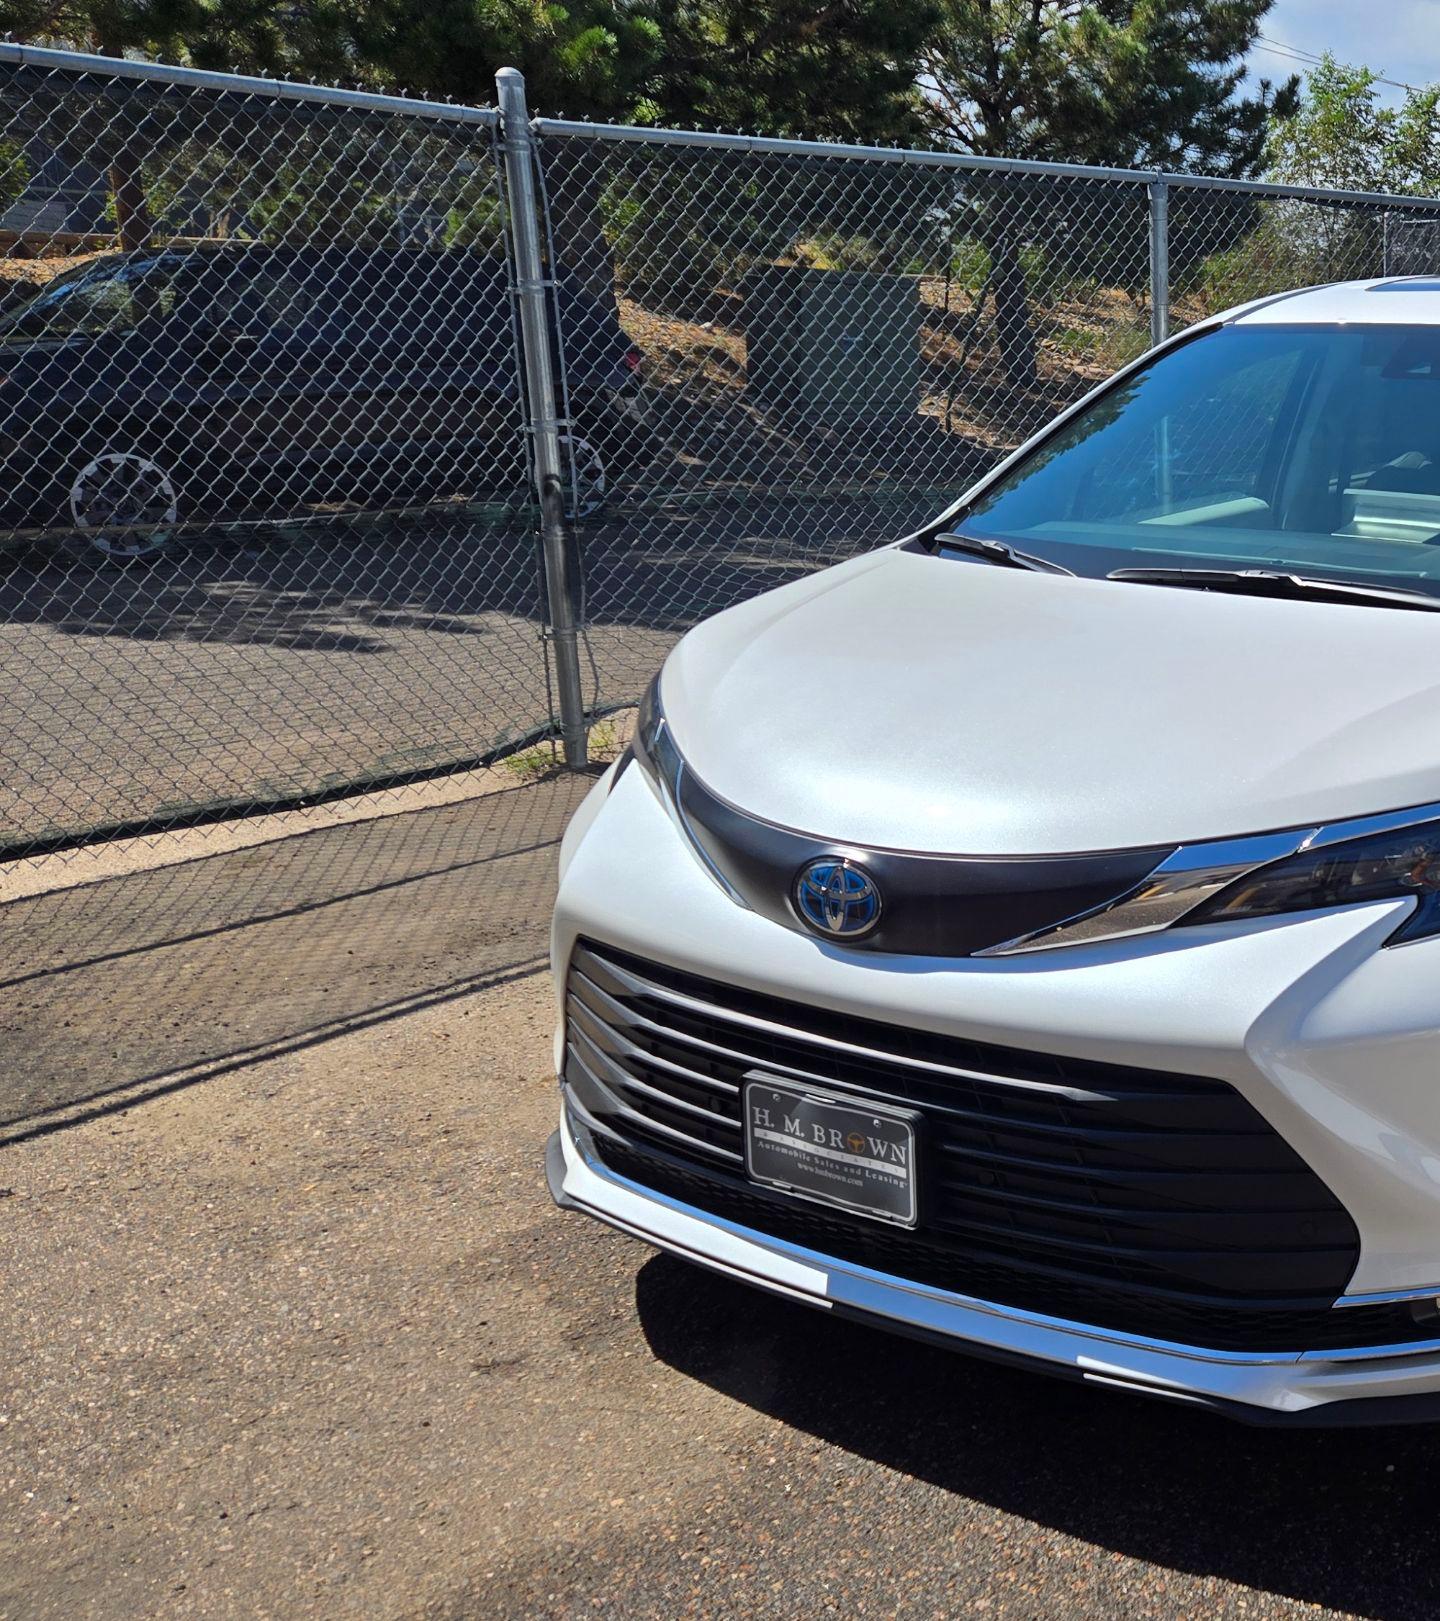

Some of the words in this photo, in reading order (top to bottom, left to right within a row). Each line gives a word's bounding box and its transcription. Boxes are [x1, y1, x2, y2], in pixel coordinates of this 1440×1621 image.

[752, 1106, 775, 1128] H.
[783, 1114, 805, 1137] M.
[811, 1123, 907, 1164] BROWN
[757, 1141, 811, 1162] Automobile
[814, 1156, 840, 1170] Sales
[843, 1165, 862, 1176] and
[865, 1169, 904, 1189] Leasing
